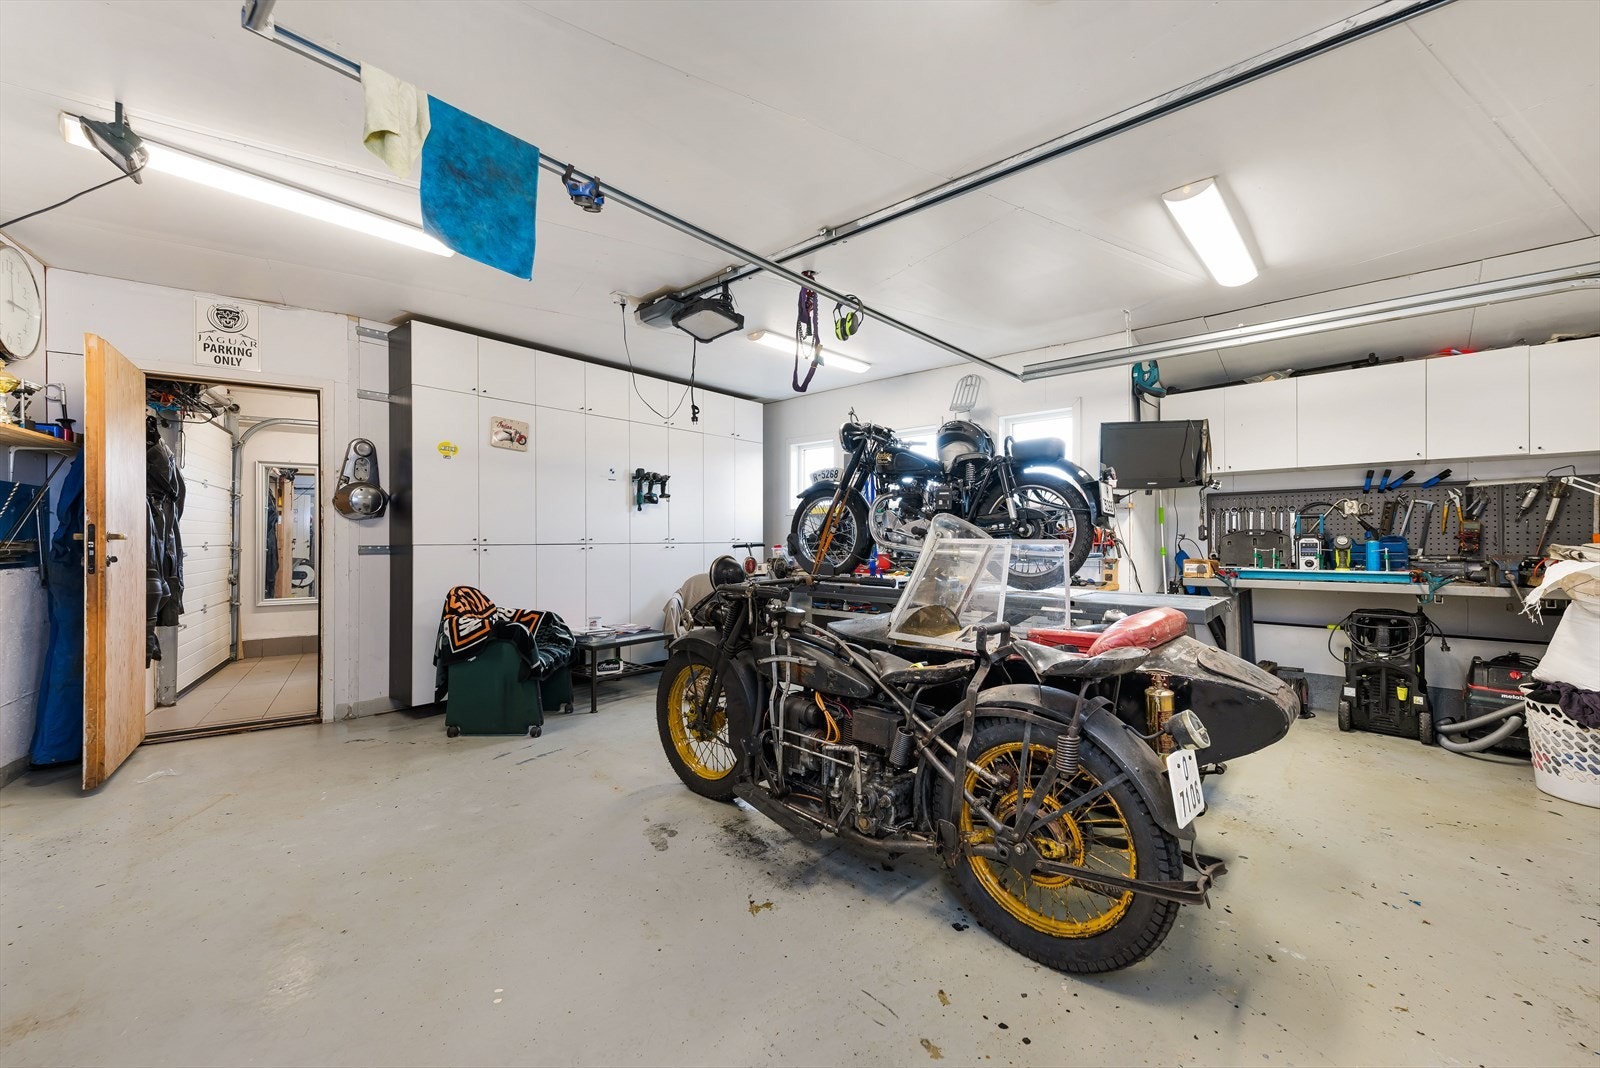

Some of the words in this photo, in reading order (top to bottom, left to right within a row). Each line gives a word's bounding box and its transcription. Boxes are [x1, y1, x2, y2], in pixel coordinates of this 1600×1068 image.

[198, 334, 257, 348] JAGUAR
[203, 343, 253, 358] PARKING
[213, 355, 242, 367] ONLY
[1179, 780, 1201, 818] 7106
